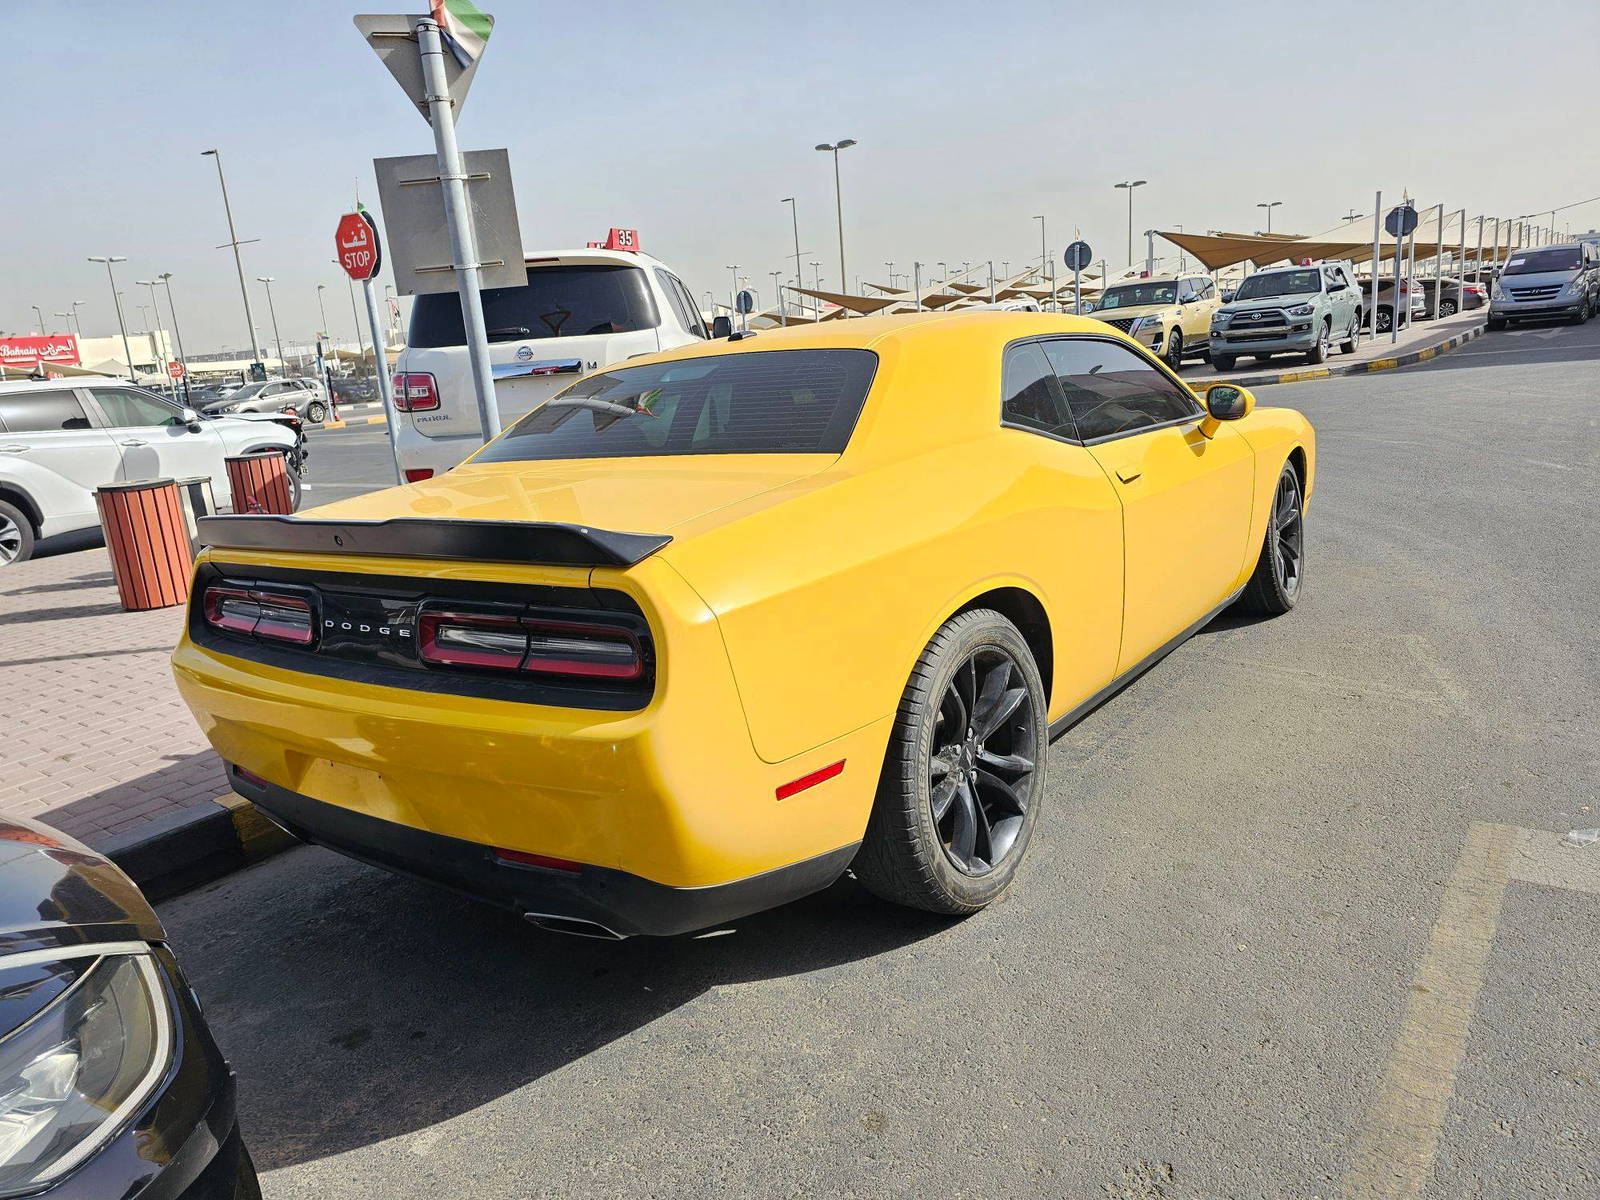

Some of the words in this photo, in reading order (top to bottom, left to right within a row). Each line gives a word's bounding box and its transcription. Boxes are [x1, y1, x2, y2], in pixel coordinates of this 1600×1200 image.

[342, 223, 367, 248] قف
[618, 230, 633, 246] 35
[344, 250, 370, 269] STOP
[0, 344, 37, 357] Bahrain
[38, 339, 75, 356] البحرين
[324, 619, 411, 638] DODGE
